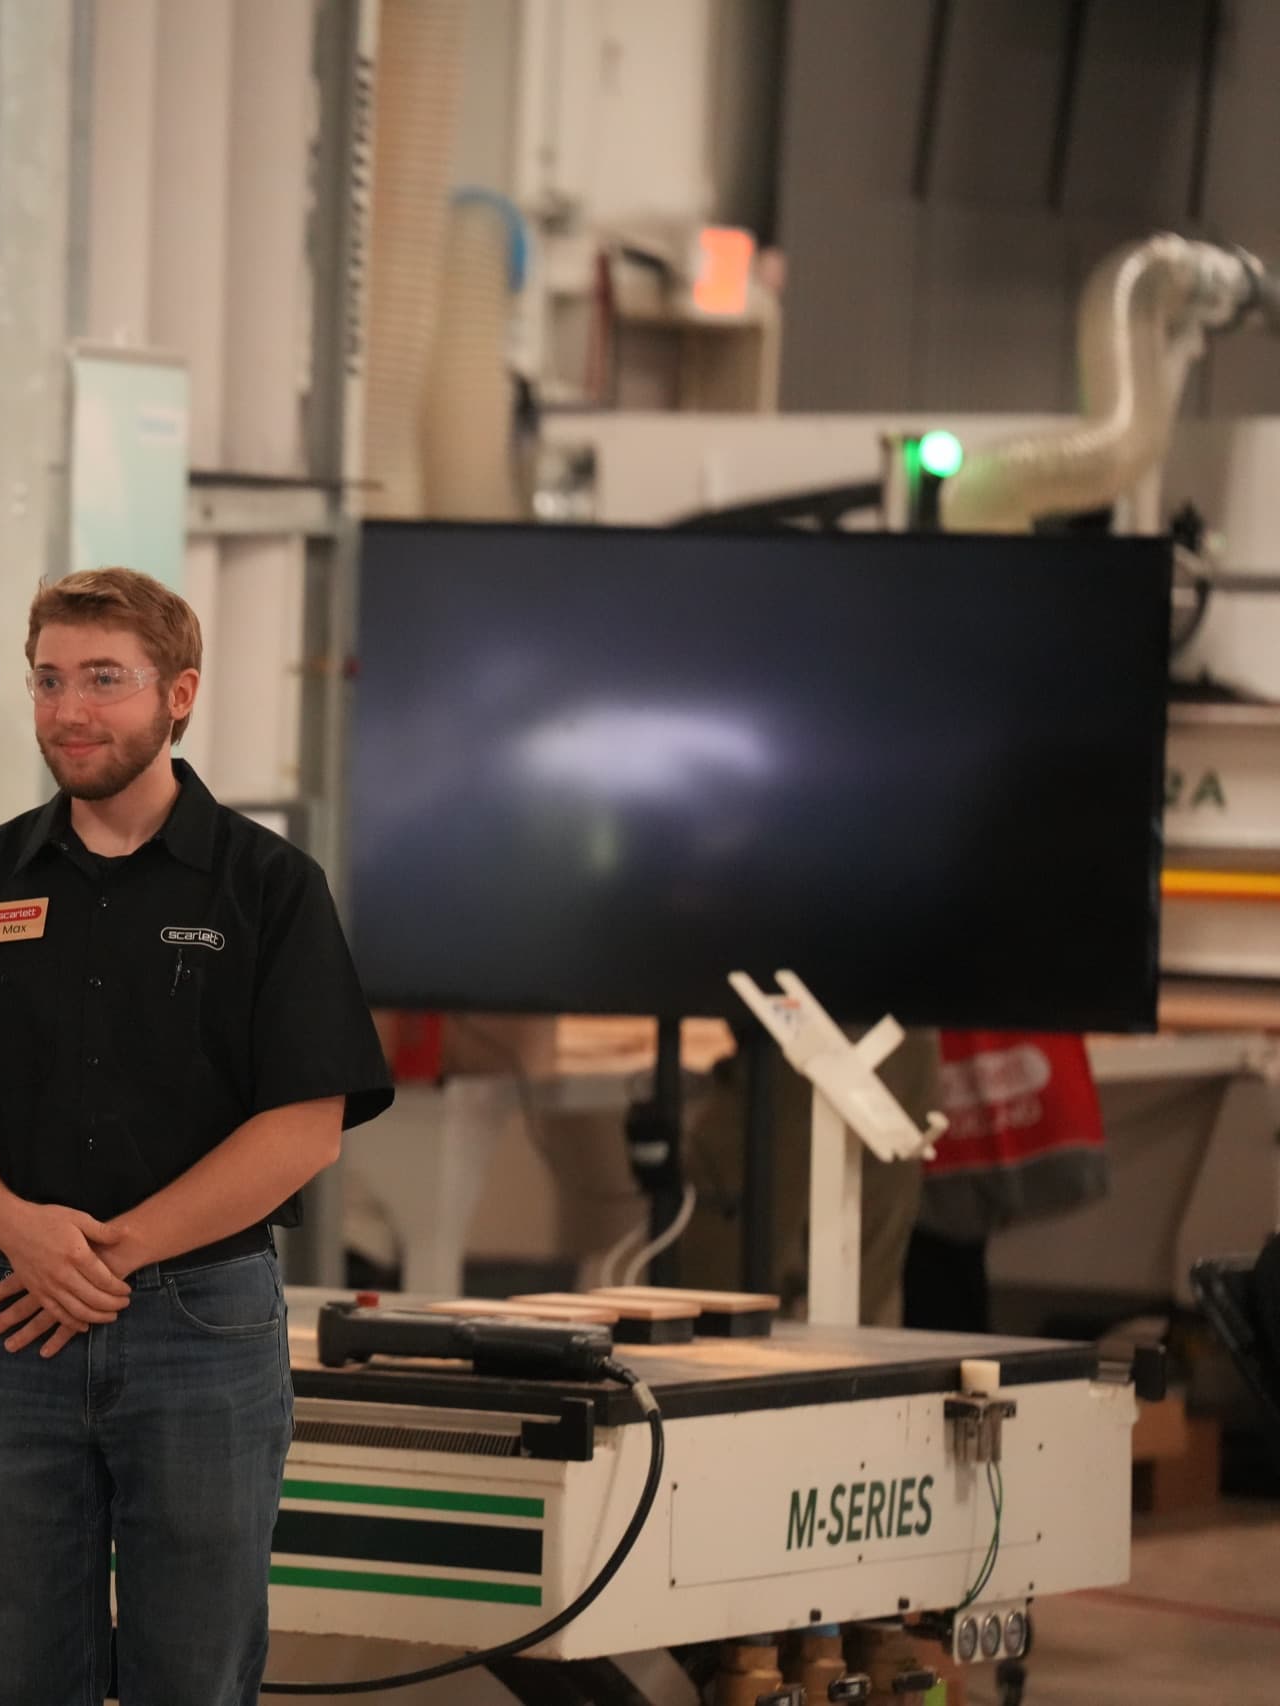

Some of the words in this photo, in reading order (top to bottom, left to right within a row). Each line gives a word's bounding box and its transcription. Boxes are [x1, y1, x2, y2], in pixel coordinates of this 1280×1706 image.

[2, 924, 27, 935] Max
[168, 930, 219, 945] scarlett
[785, 1474, 934, 1551] M-SERIES
